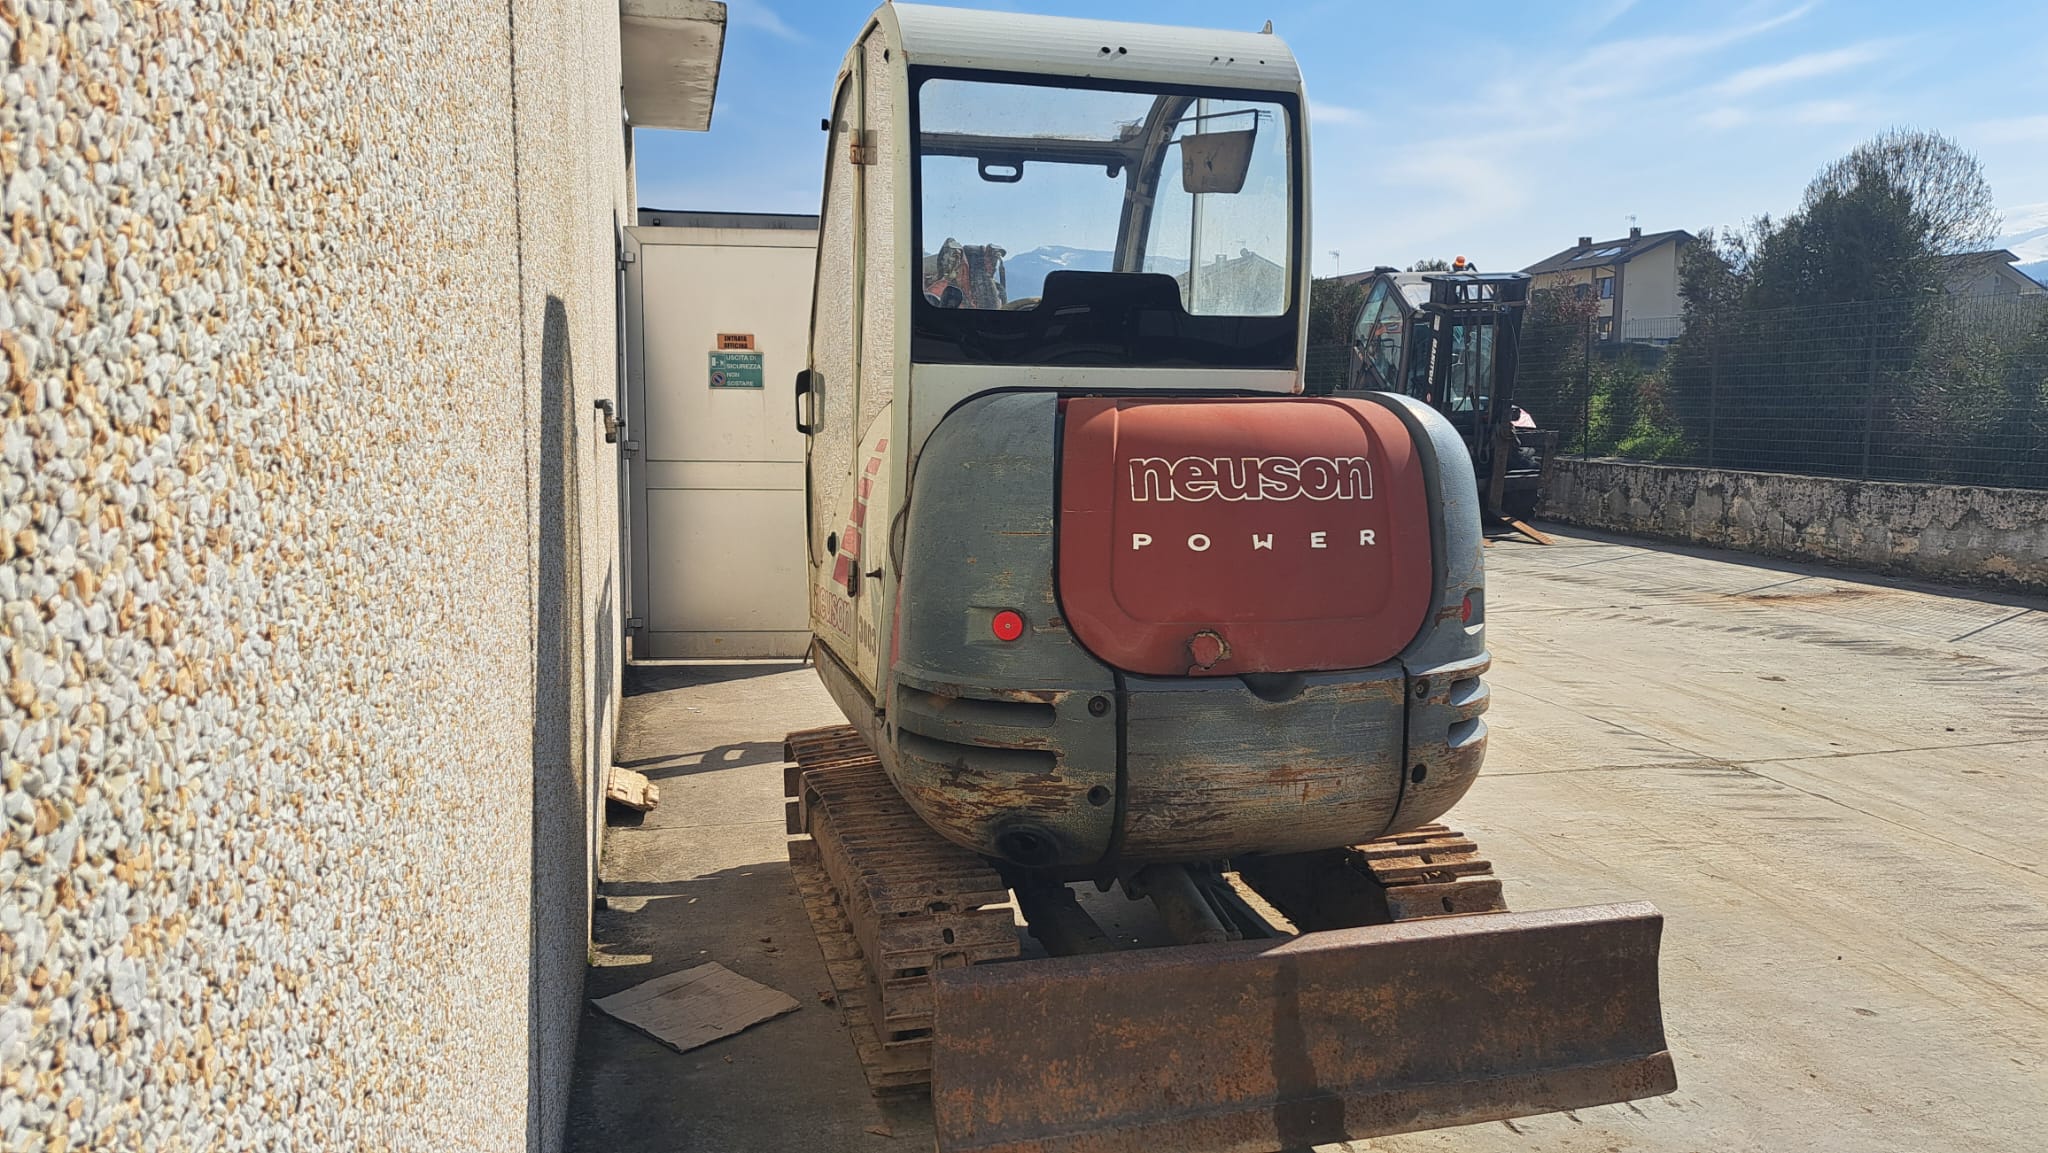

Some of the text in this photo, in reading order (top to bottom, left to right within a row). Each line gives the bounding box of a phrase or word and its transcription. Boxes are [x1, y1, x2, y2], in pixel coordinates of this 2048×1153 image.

[1428, 338, 1437, 385] MANITOU
[1129, 456, 1374, 502] neuson
[1132, 529, 1376, 551] POWER
[814, 585, 850, 637] neuson
[858, 615, 877, 656] 3003
